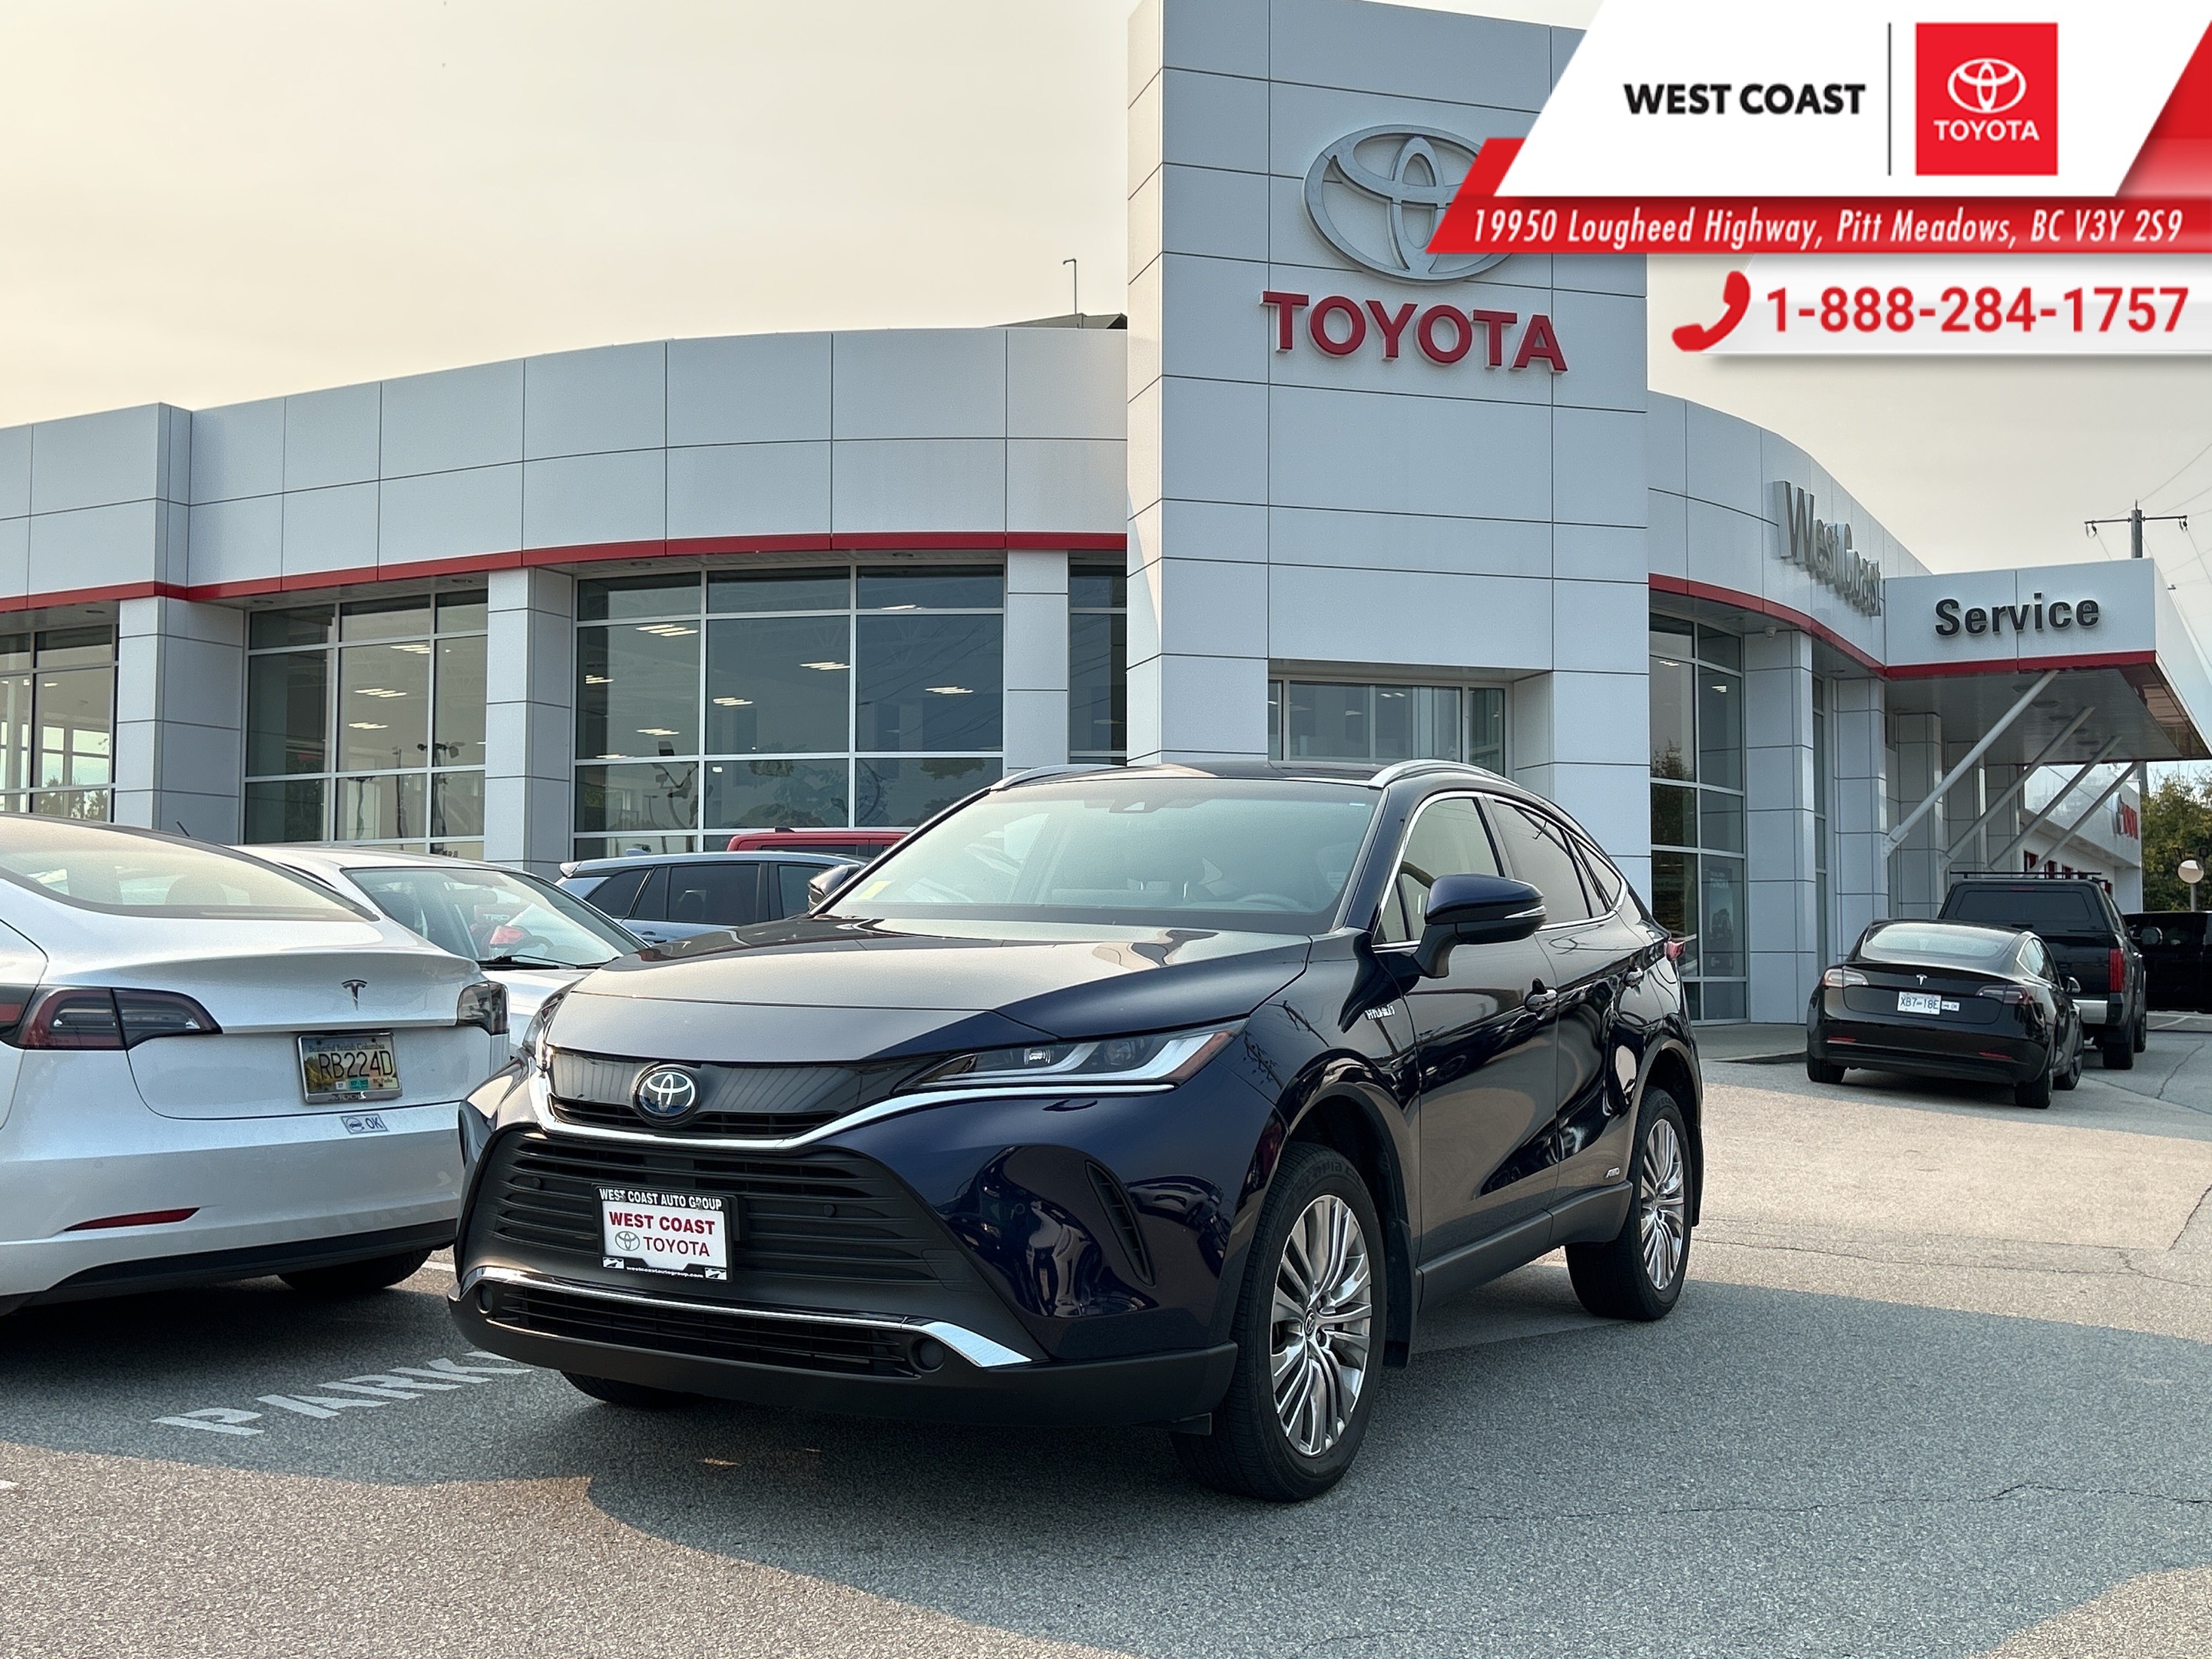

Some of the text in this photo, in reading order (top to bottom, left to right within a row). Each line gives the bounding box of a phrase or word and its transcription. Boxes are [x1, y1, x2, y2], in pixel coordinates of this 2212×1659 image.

[1260, 290, 1568, 375] TOYOTA
[1773, 481, 1881, 616] West Coast
[1935, 591, 2100, 636] Service
[318, 1051, 394, 1079] RB224D
[365, 1117, 383, 1130] OK
[599, 1188, 626, 1202] WEST
[628, 1190, 658, 1205] COAST
[661, 1194, 687, 1207] AUTO
[608, 1211, 715, 1235] WEST COAST
[643, 1236, 710, 1257] TOYOTA
